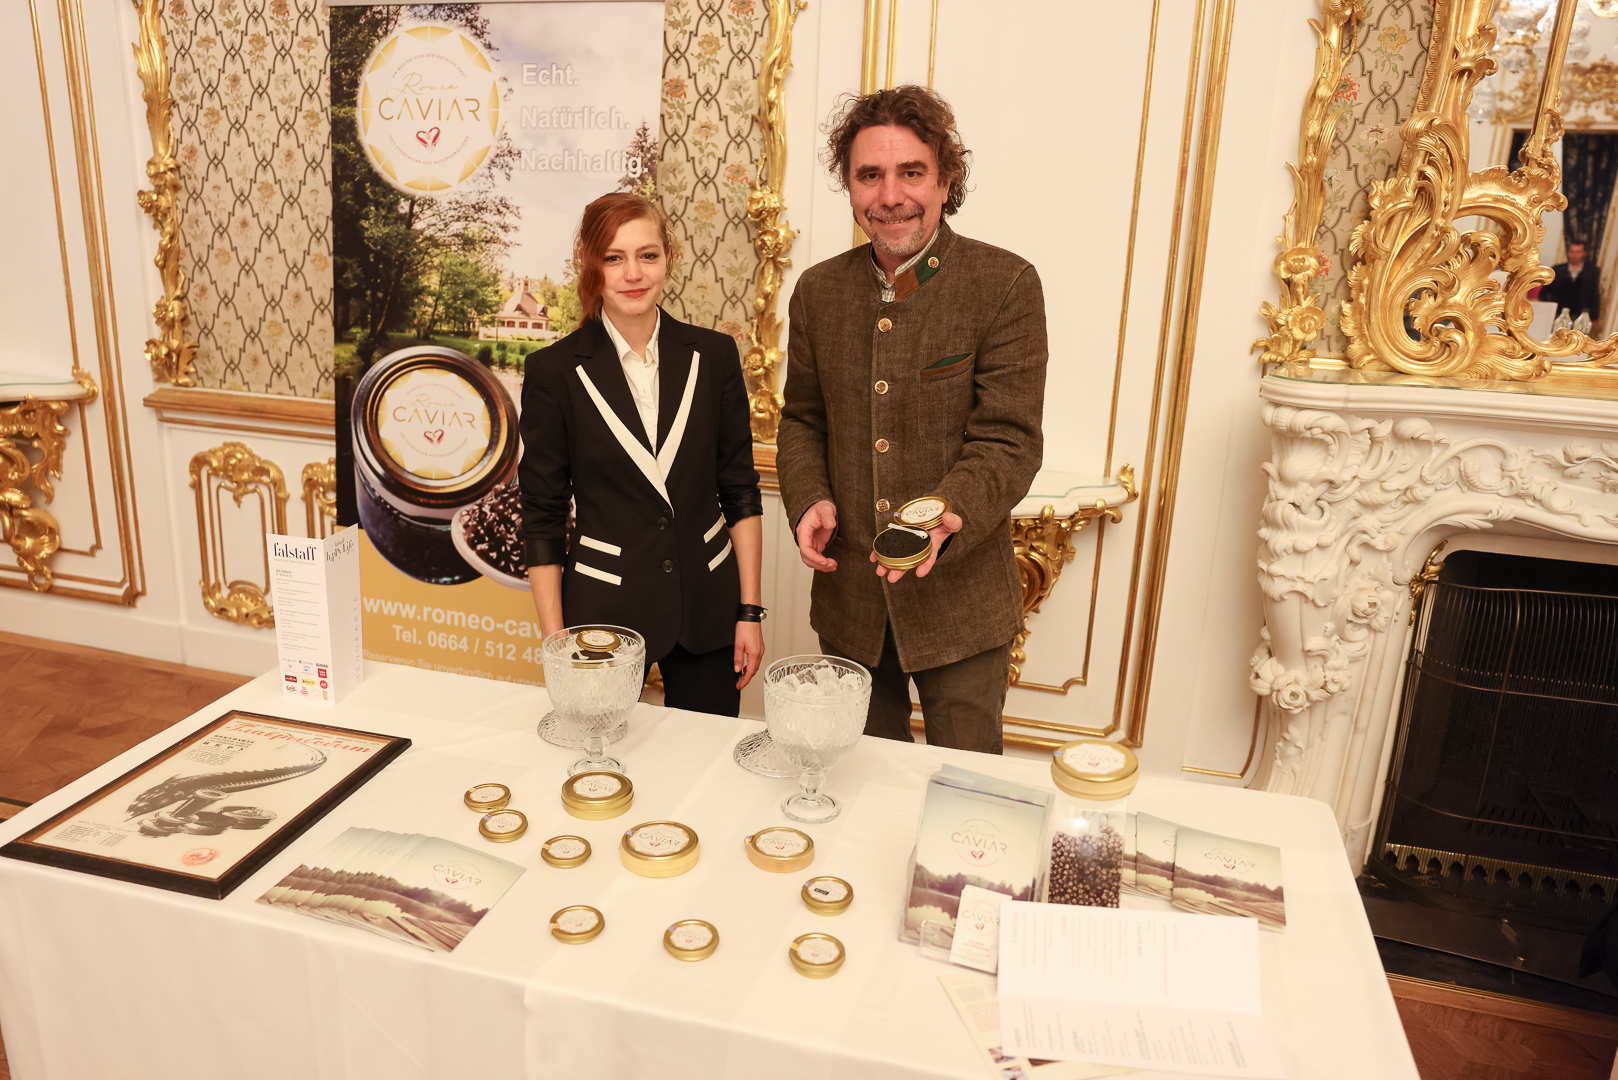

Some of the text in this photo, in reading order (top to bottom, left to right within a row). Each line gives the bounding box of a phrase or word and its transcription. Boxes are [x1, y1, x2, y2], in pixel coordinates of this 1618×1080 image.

[522, 63, 579, 85] Echt.
[378, 97, 481, 122] CAVIAR
[521, 106, 630, 129] Natürlich.
[520, 149, 648, 177] Nachhaltig.
[392, 406, 476, 429] CAVIAR
[273, 542, 317, 561] falstaff
[392, 624, 422, 645] Tel.
[427, 630, 469, 653] 0664
[473, 637, 480, 654] /
[485, 640, 517, 661] 512
[417, 658, 432, 670] Sie
[638, 832, 681, 846] CAVIAR
[762, 838, 801, 848] CAVIAR
[951, 831, 1008, 854] CAVIAR
[1204, 852, 1256, 868] CAVIAR
[433, 864, 482, 886] CAVIAR
